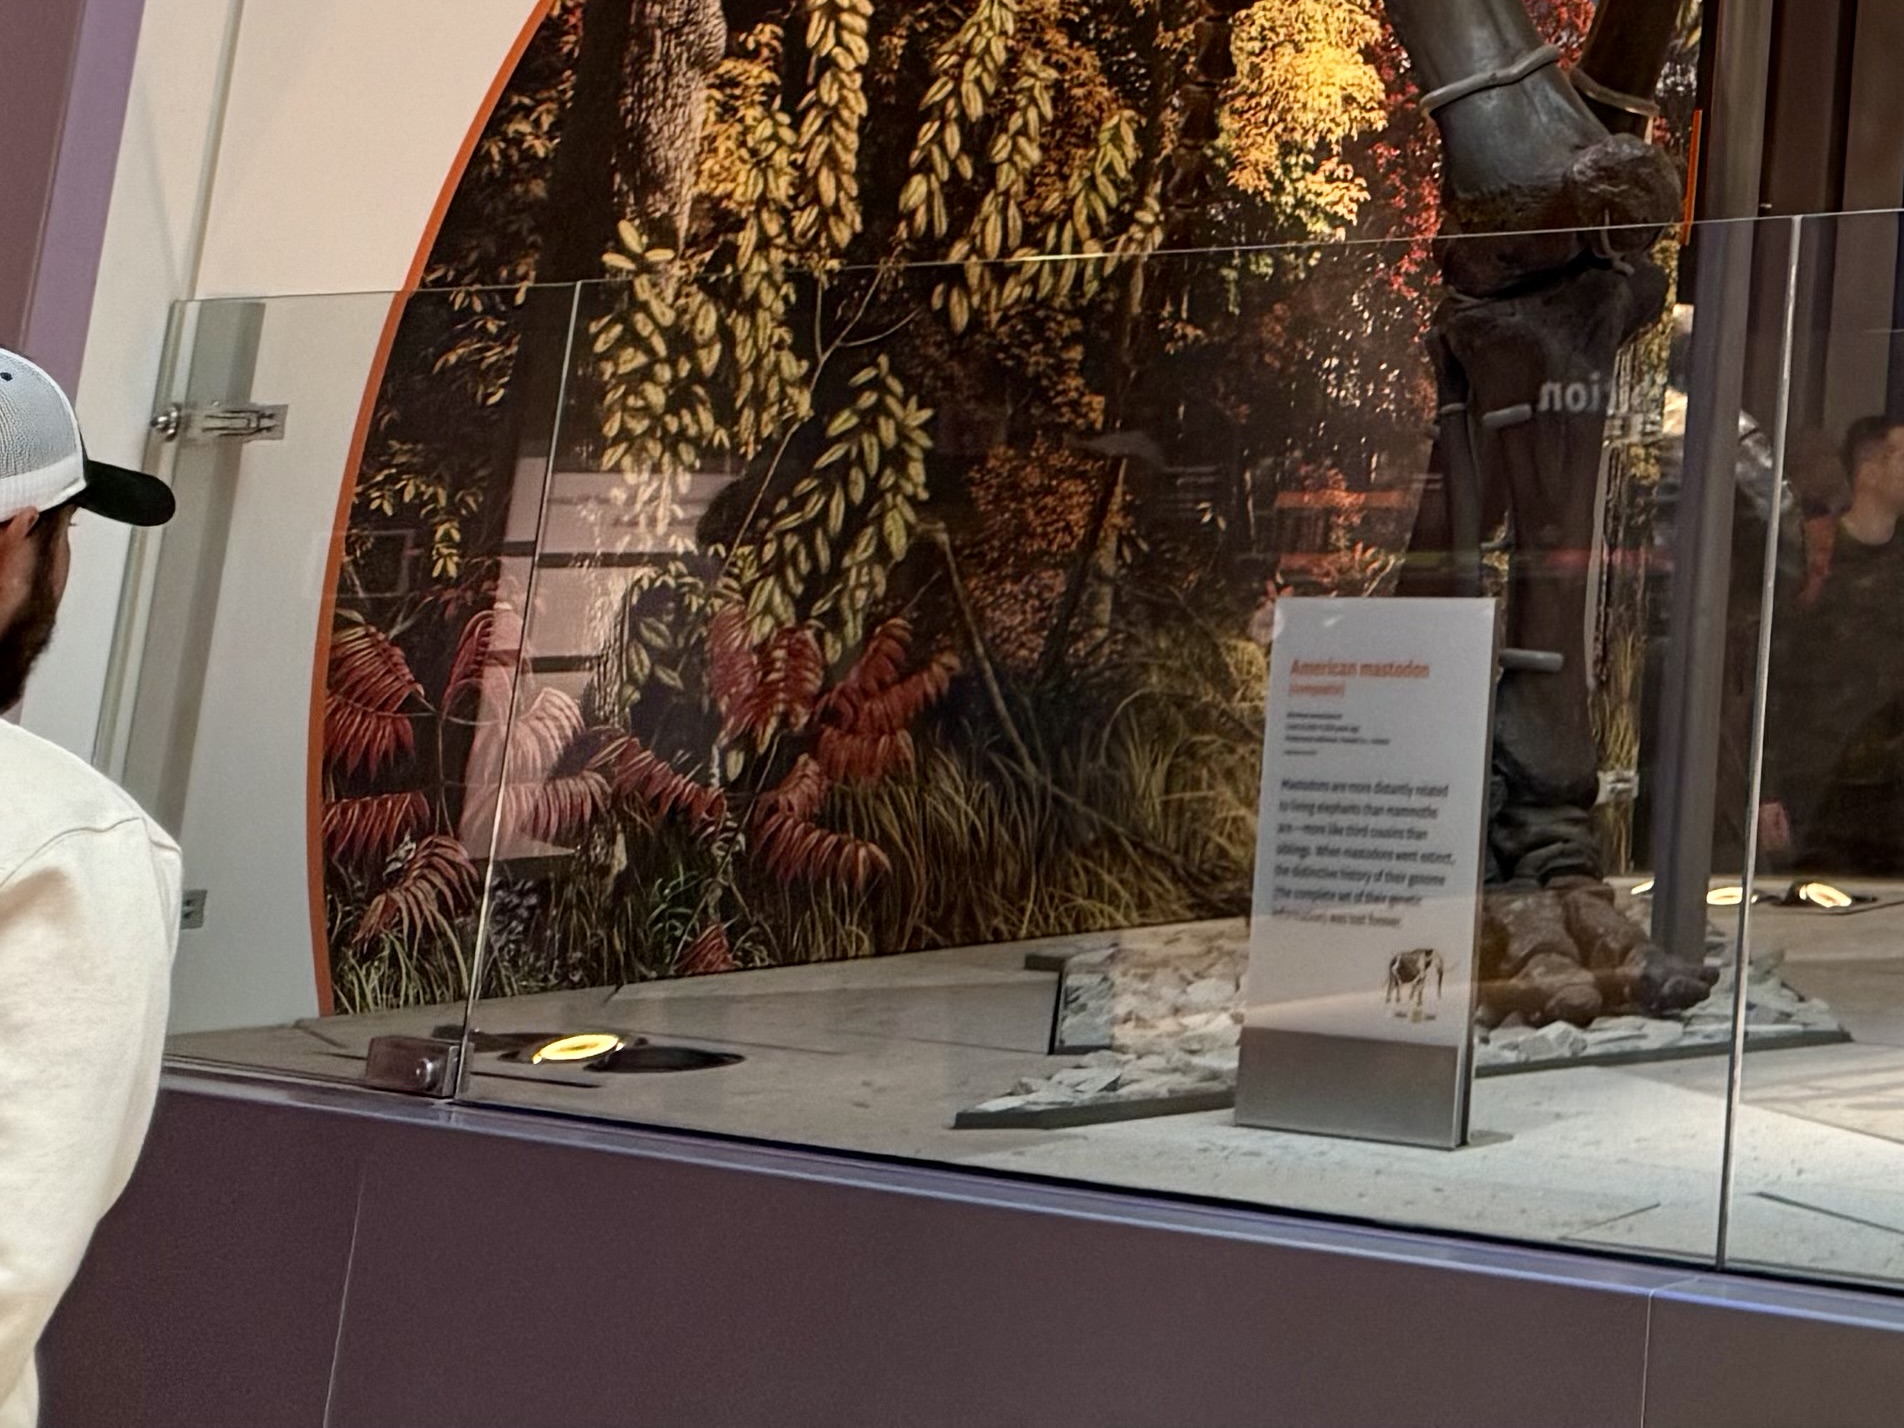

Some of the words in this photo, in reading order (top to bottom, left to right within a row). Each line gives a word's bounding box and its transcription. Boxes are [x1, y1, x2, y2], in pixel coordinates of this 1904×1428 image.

[1290, 659, 1357, 676] American
[1360, 660, 1430, 678] mastodon
[1281, 779, 1330, 792] Mastodons
[1331, 782, 1347, 793] are
[1348, 783, 1372, 794] more
[1373, 781, 1413, 798] distantly
[1415, 784, 1449, 797] related
[1317, 801, 1361, 816] elephants
